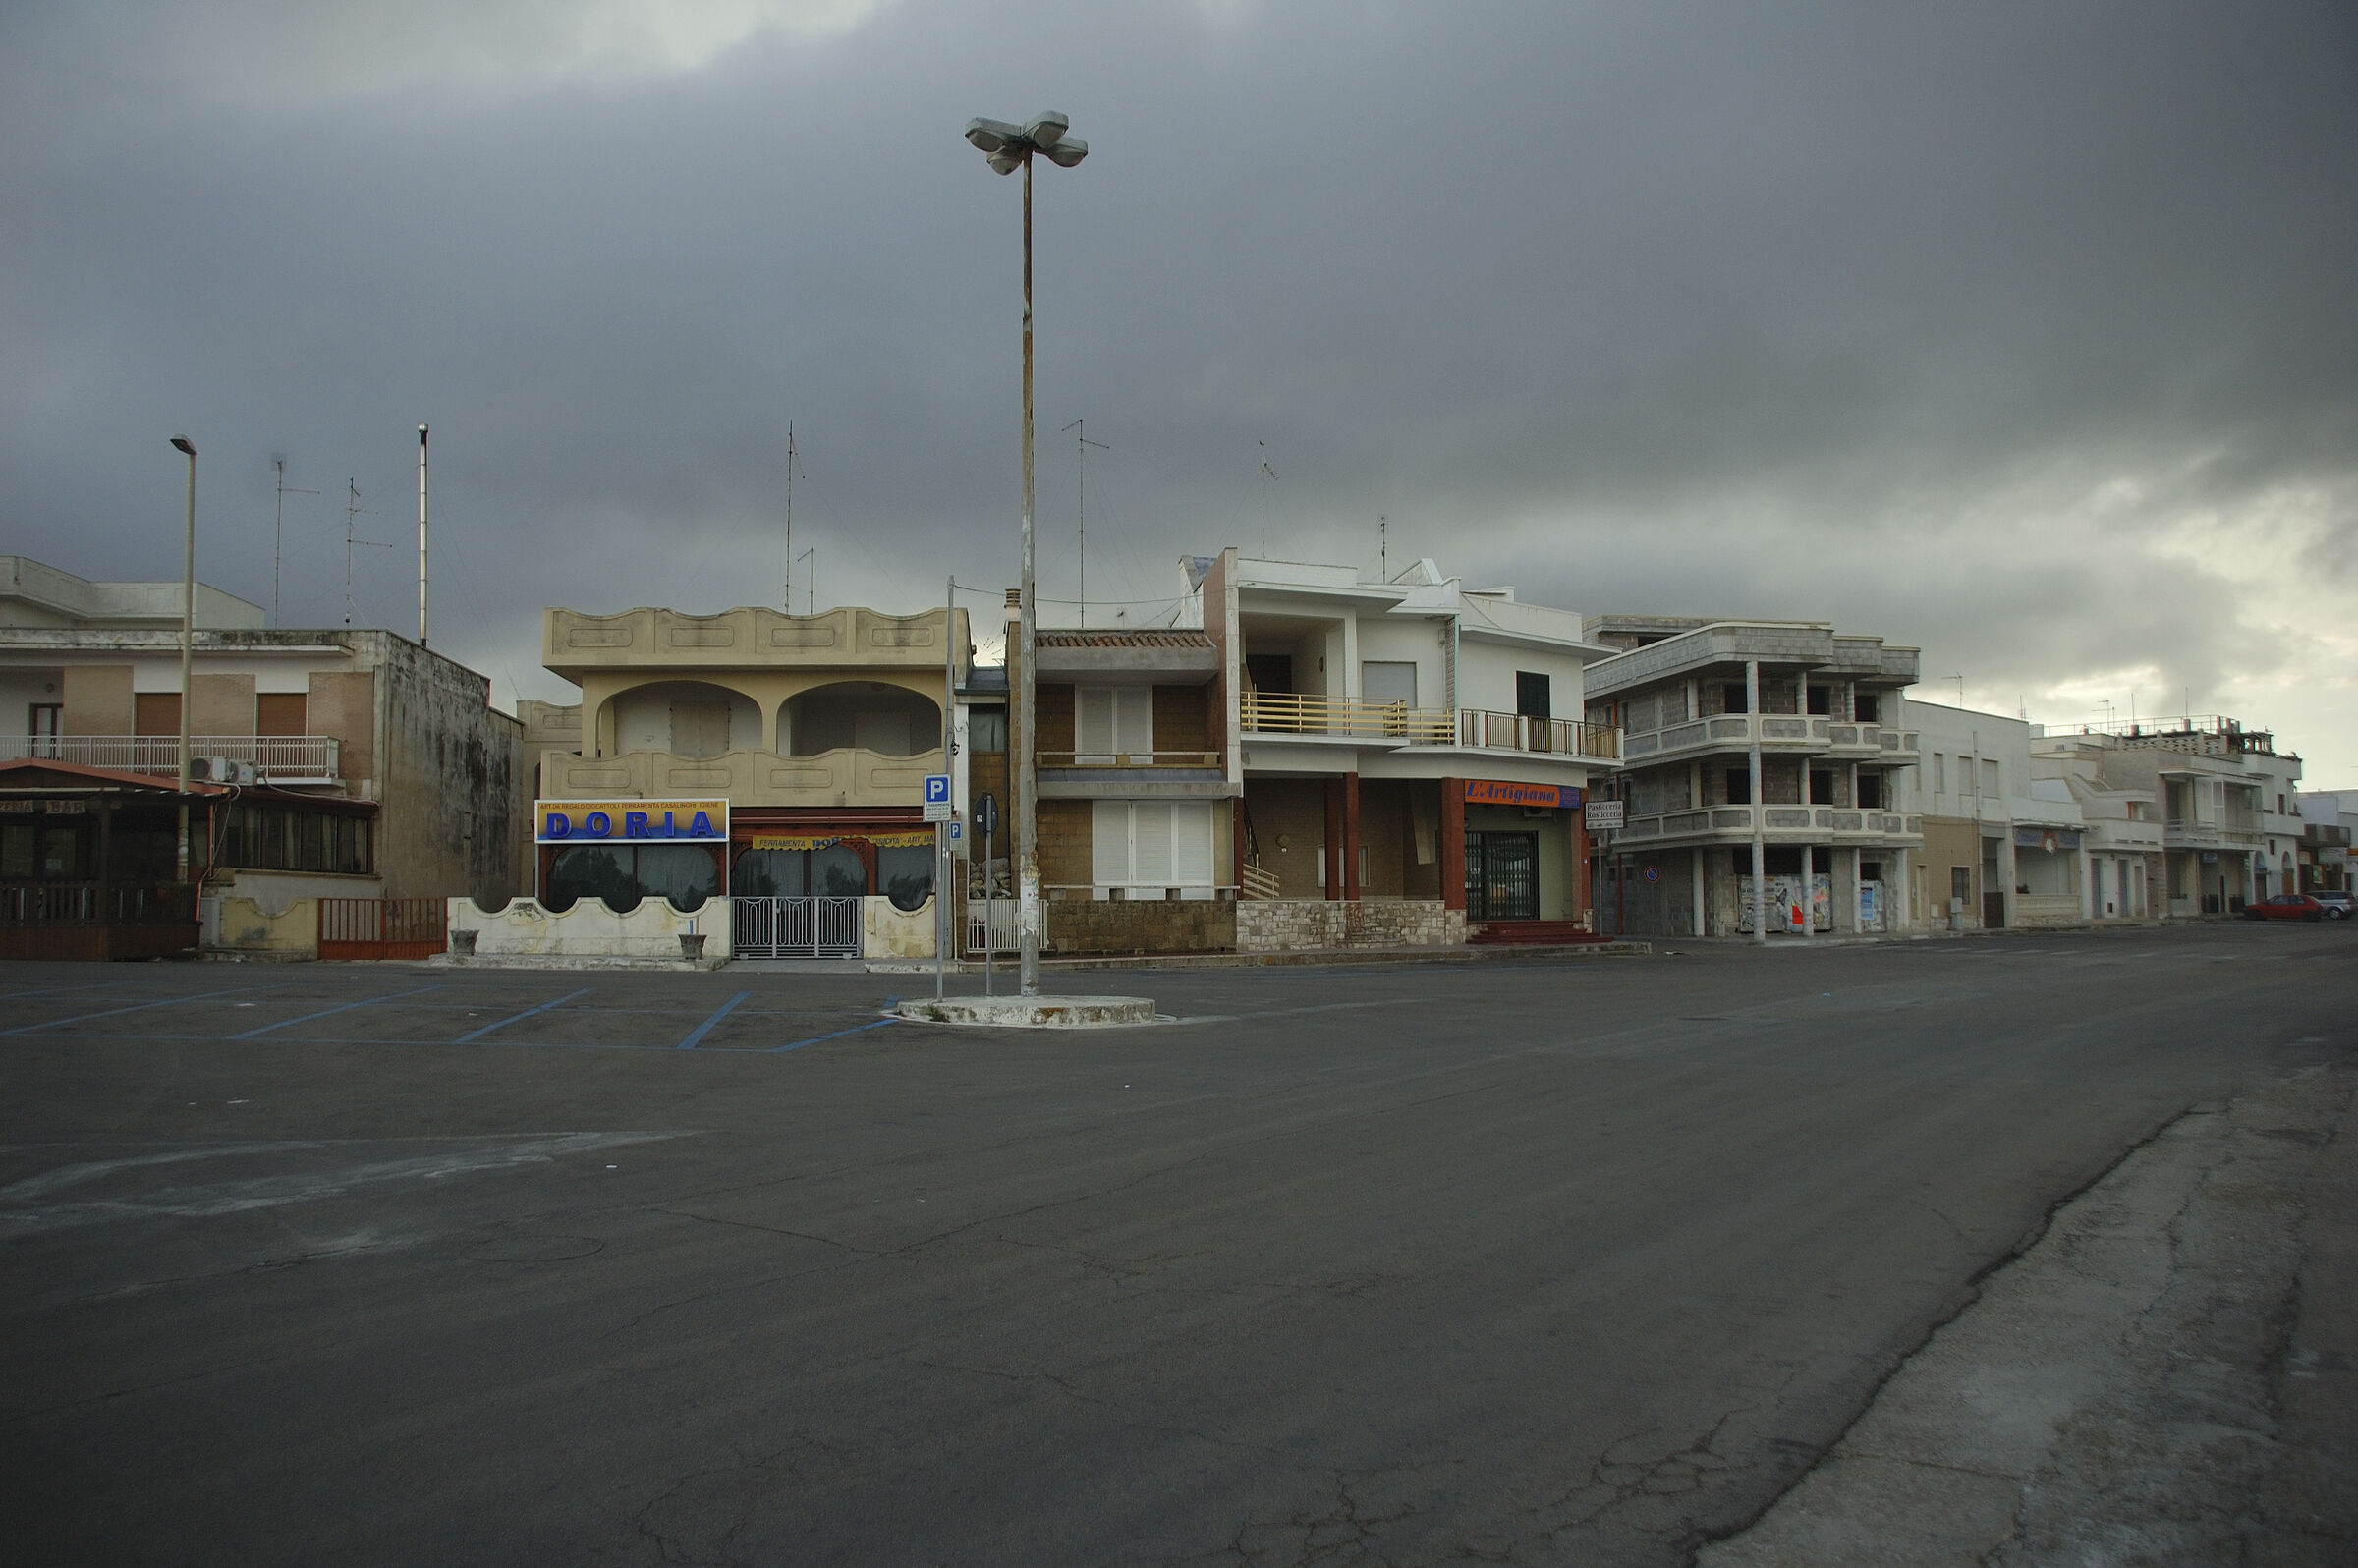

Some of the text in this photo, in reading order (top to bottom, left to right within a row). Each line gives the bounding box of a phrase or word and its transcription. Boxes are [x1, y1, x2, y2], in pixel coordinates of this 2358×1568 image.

[930, 780, 943, 799] P
[1466, 781, 1556, 803] L'Artigiana
[51, 801, 84, 812] BAR
[1588, 803, 1621, 812] Pasticceria
[1588, 811, 1622, 819] Rosticceria
[545, 810, 716, 840] DORIA
[952, 825, 959, 838] P
